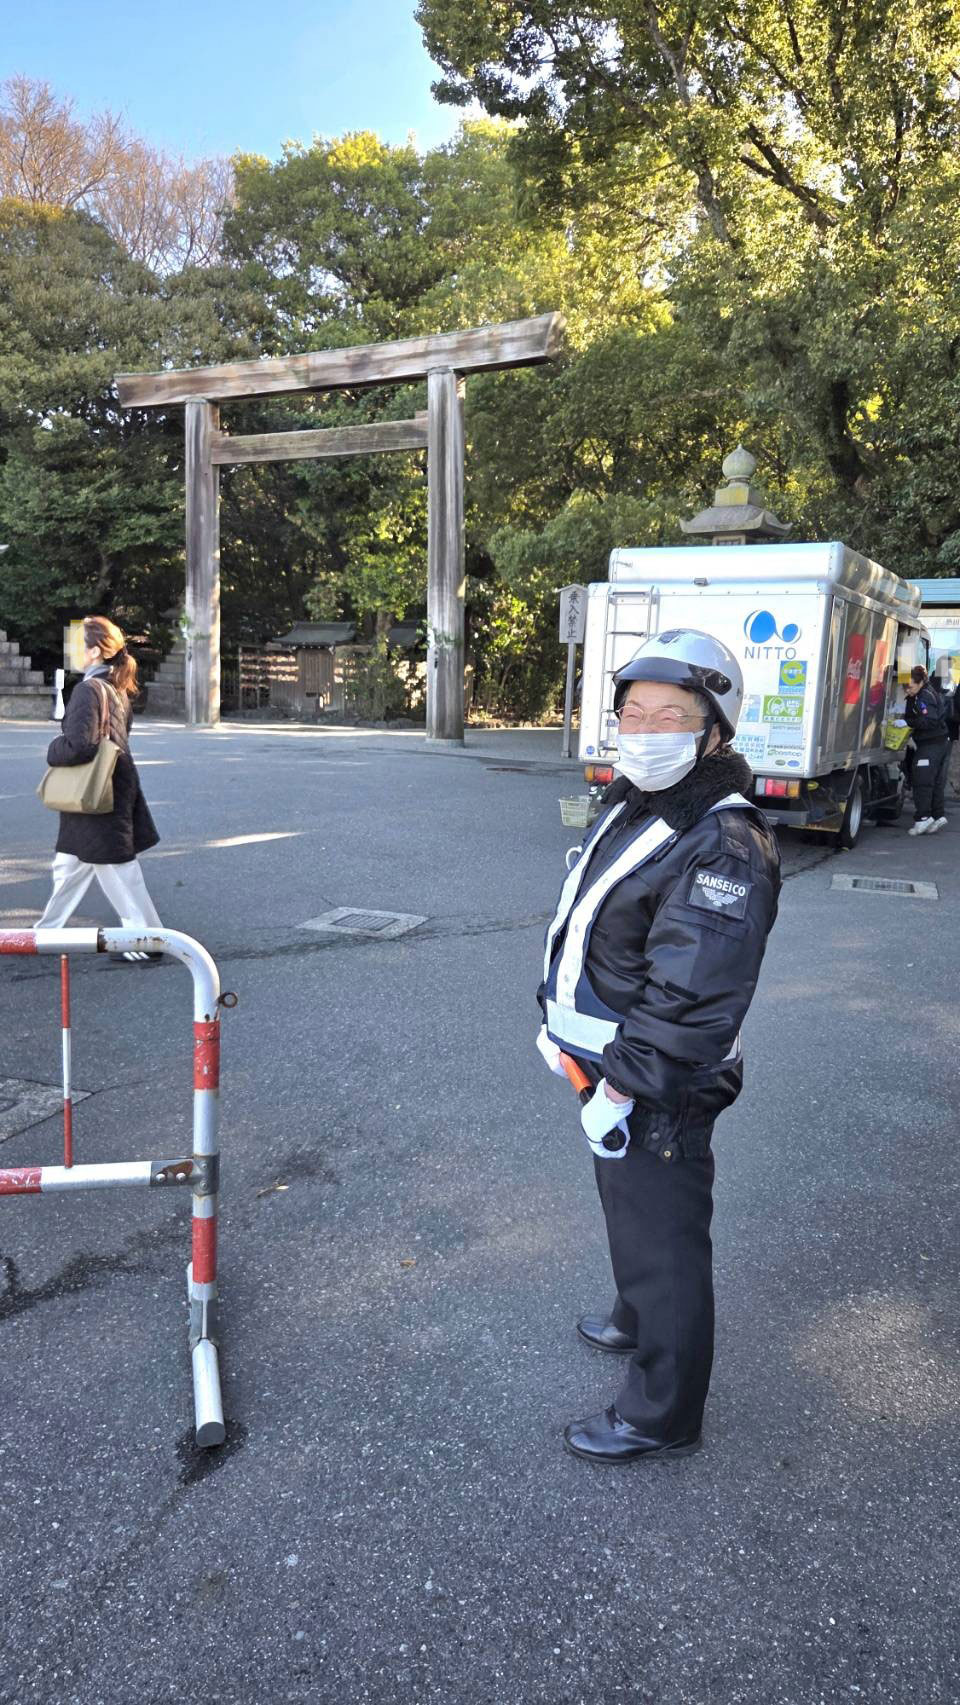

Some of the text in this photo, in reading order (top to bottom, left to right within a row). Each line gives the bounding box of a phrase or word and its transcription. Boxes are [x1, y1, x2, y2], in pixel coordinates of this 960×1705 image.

[567, 591, 580, 638] 乗入禁止
[744, 646, 797, 660] NITTO
[696, 873, 746, 897] SANSEICO
